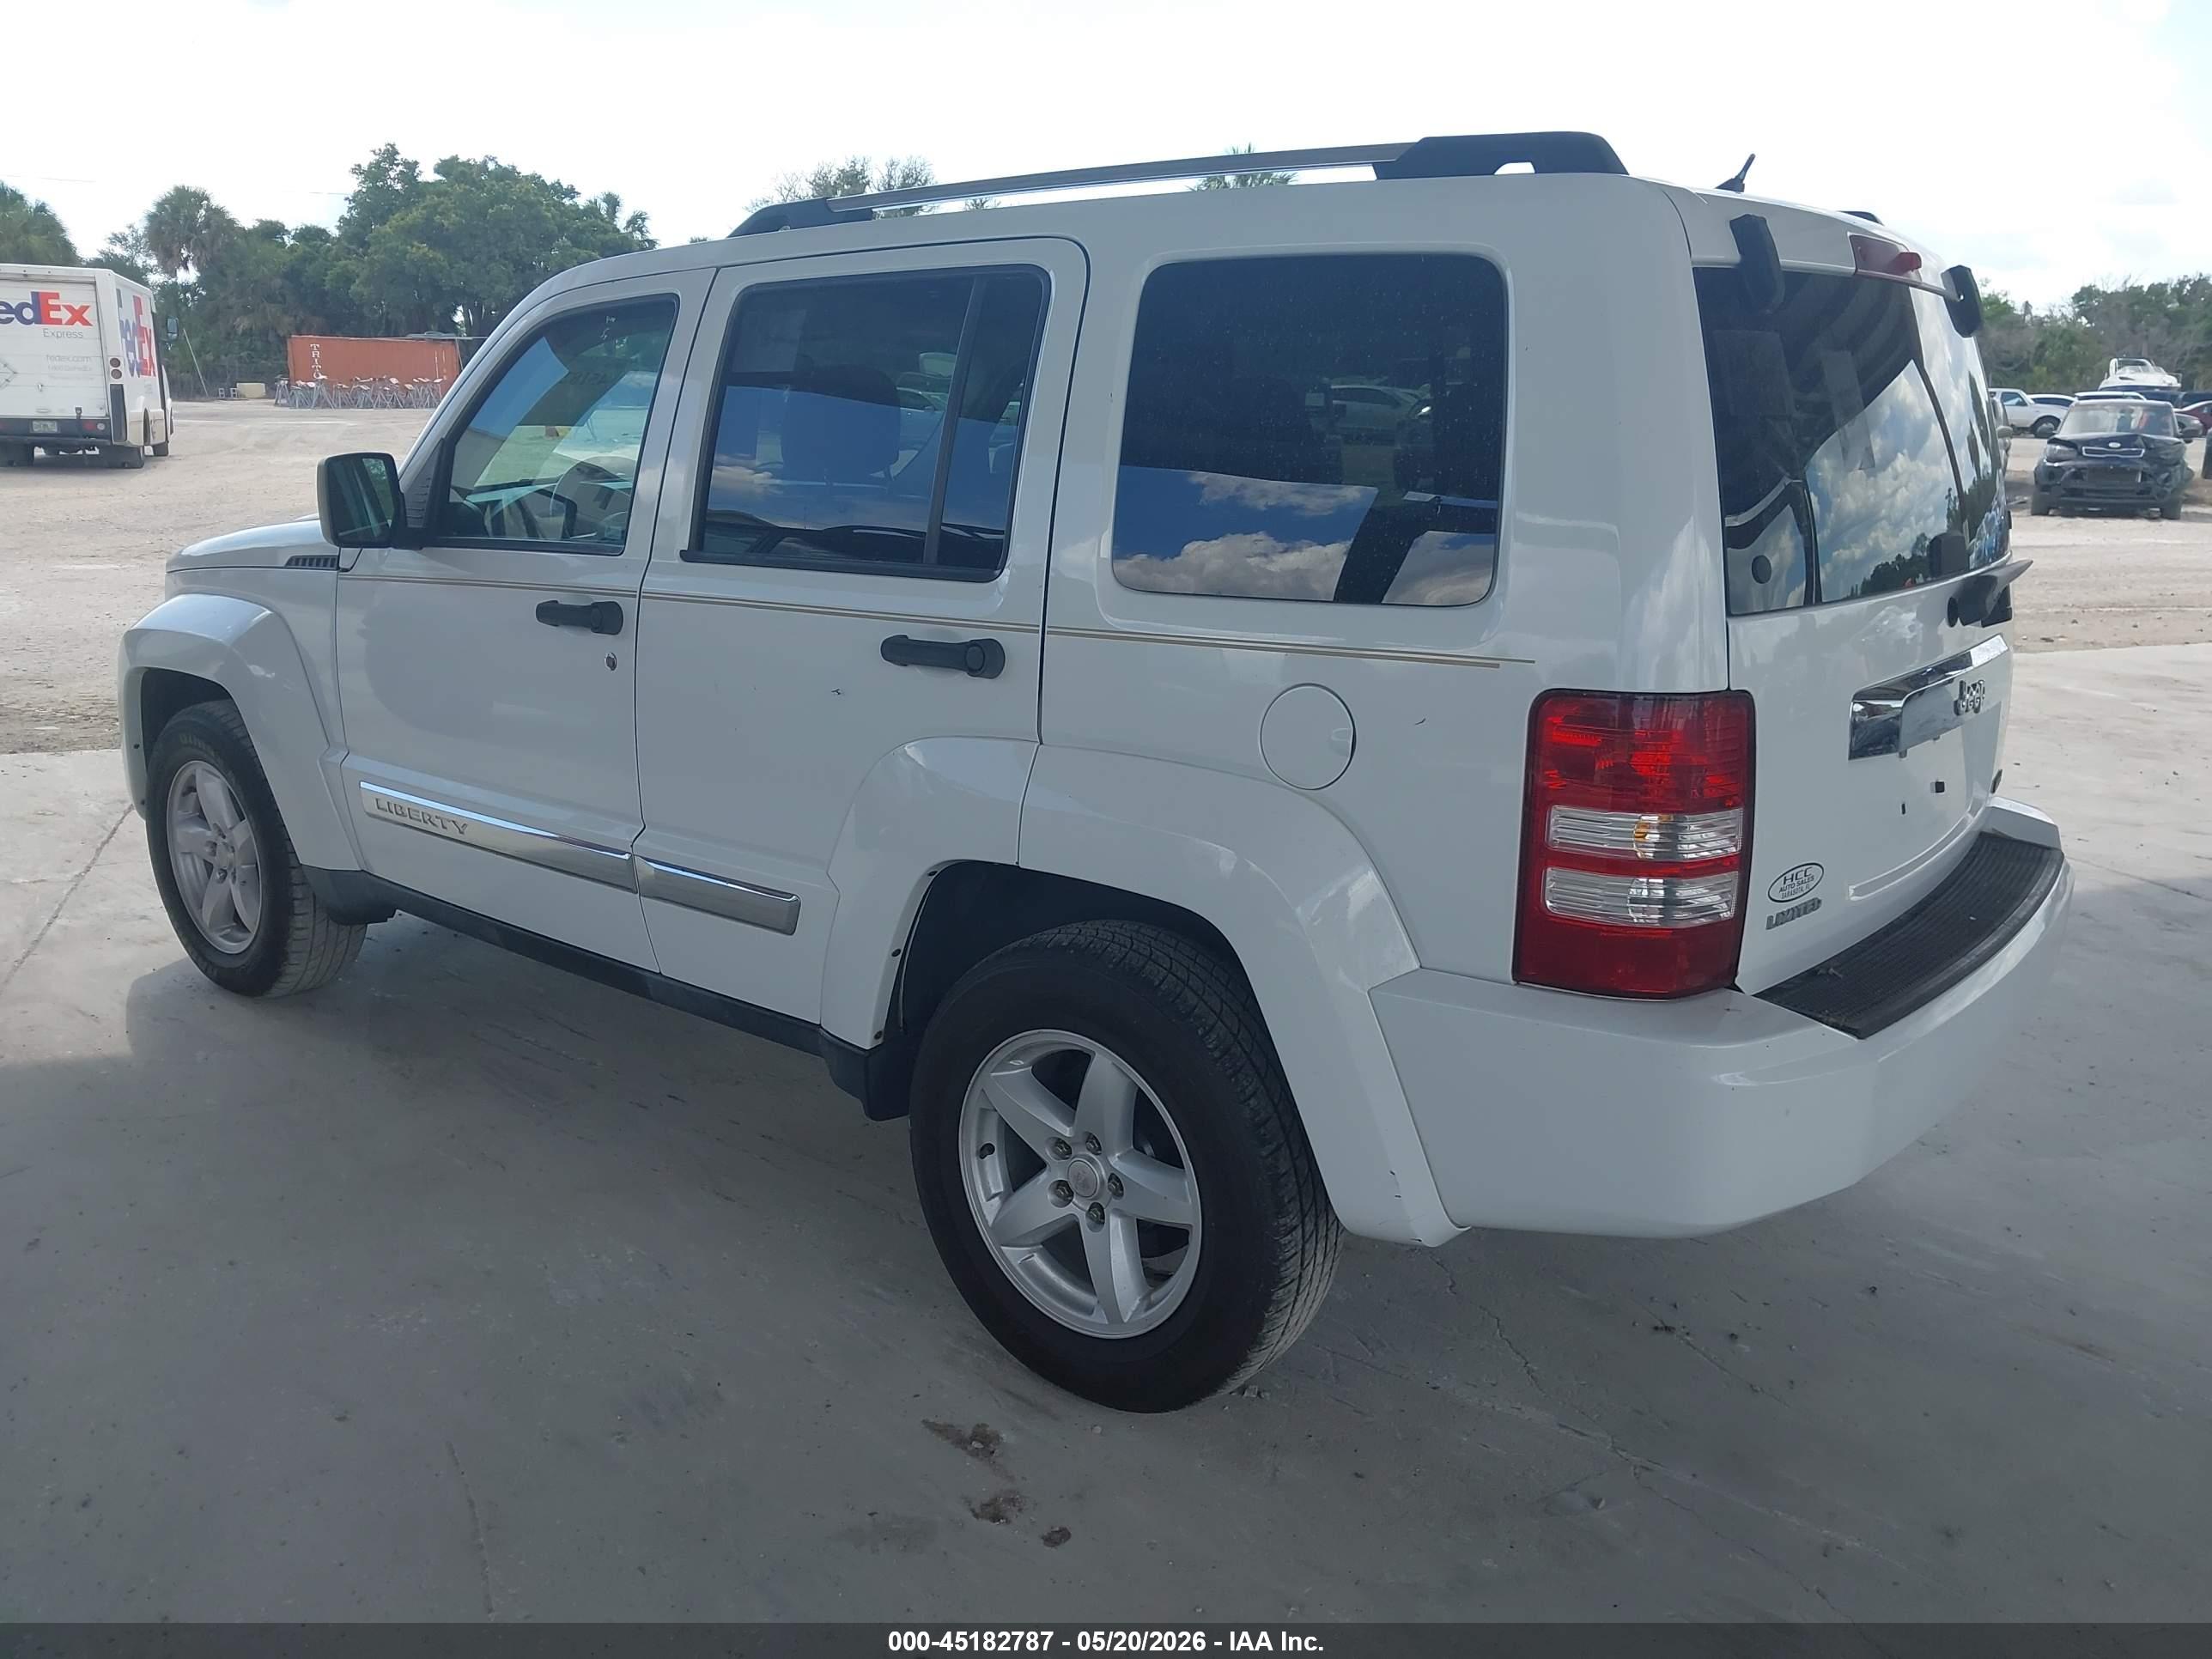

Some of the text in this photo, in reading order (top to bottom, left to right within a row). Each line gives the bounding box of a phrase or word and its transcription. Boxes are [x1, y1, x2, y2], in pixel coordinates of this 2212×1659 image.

[0, 291, 93, 326] edEx
[43, 328, 83, 340] Express
[310, 343, 322, 379] TRITO
[375, 798, 468, 835] LIBERTY
[1779, 875, 1814, 894] AUTO SALES
[1784, 866, 1813, 885] HCC
[1765, 897, 1822, 930] LIMITED
